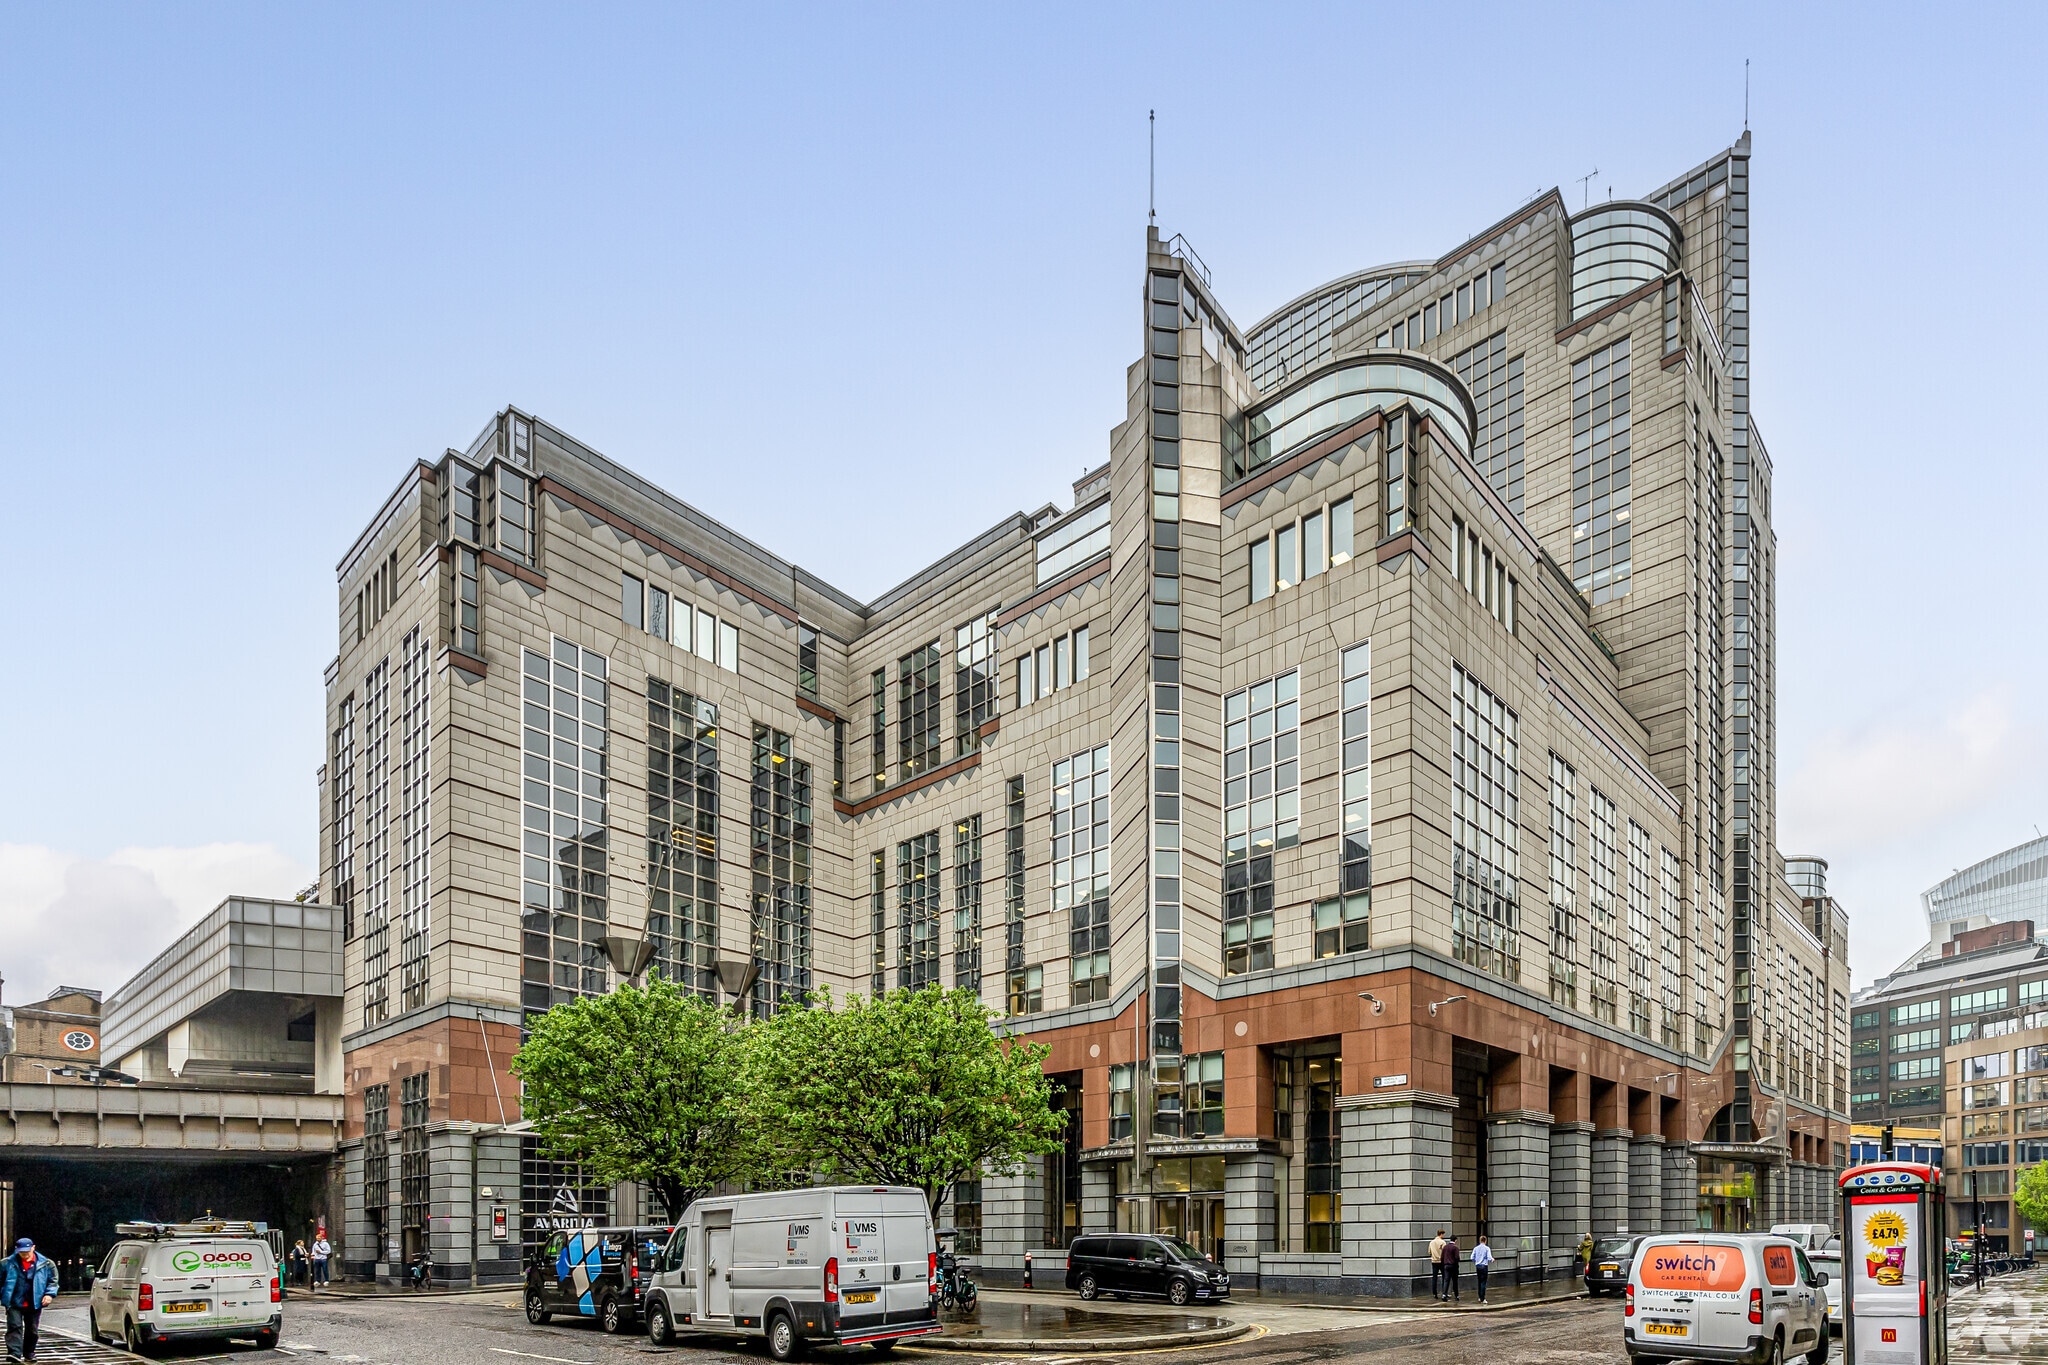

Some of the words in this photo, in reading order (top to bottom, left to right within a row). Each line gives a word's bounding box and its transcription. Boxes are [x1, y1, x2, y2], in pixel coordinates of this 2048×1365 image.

[794, 1224, 810, 1236] VMS
[854, 1222, 877, 1233] VMS
[1872, 1227, 1899, 1240] £4.79
[202, 1252, 253, 1263] 0800
[1655, 1254, 1716, 1271] switch
[203, 1261, 252, 1269] Sparks
[1641, 1290, 1741, 1300] SWITCHCARRENTAL.CO.UK
[169, 1304, 187, 1312] AV71
[1648, 1325, 1667, 1333] CF74
[1669, 1325, 1684, 1334] TZT
